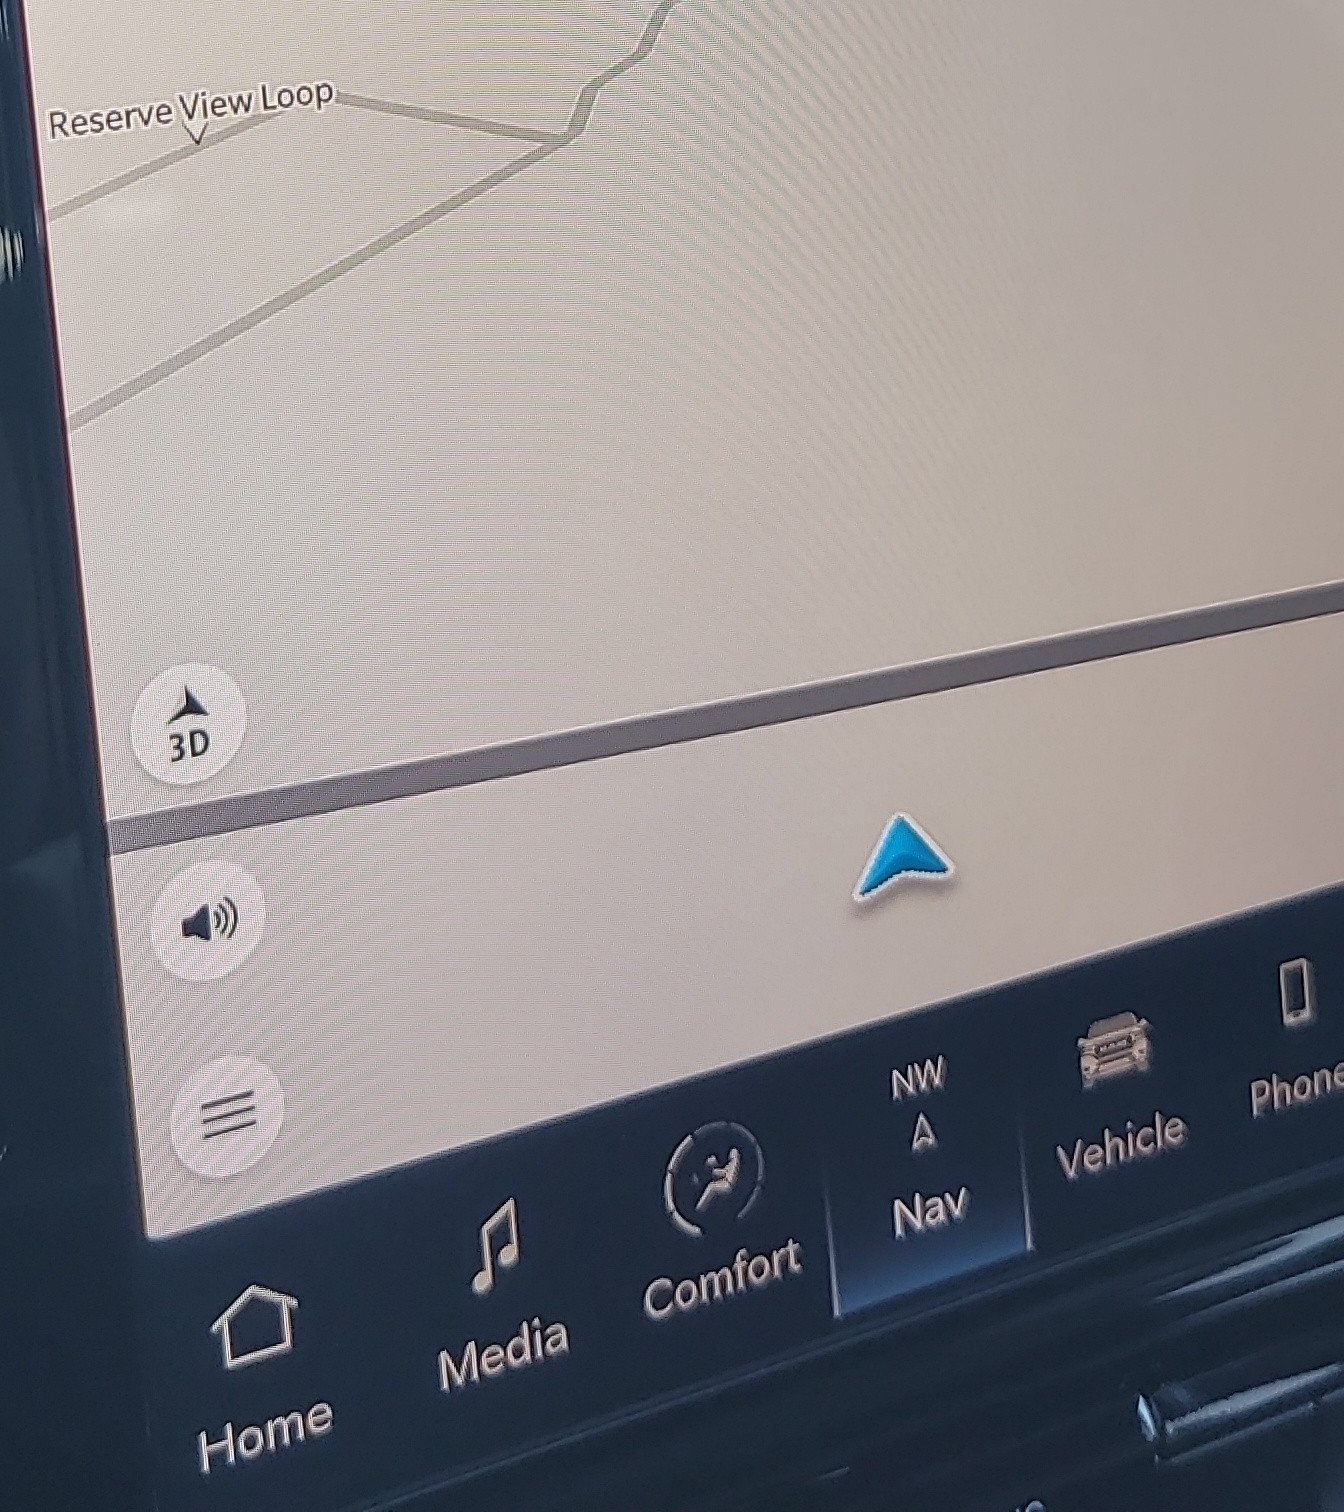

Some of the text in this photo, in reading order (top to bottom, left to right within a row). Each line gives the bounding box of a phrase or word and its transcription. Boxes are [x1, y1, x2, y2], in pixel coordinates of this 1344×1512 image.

[49, 81, 335, 140] Reserve View Loop
[168, 728, 211, 764] 3D
[890, 1054, 949, 1101] NW
[1055, 1110, 1190, 1182] Vehicle
[892, 1187, 971, 1240] Nav
[644, 1237, 804, 1319] Comfort
[438, 1316, 571, 1393] Media
[197, 1399, 335, 1475] Home
